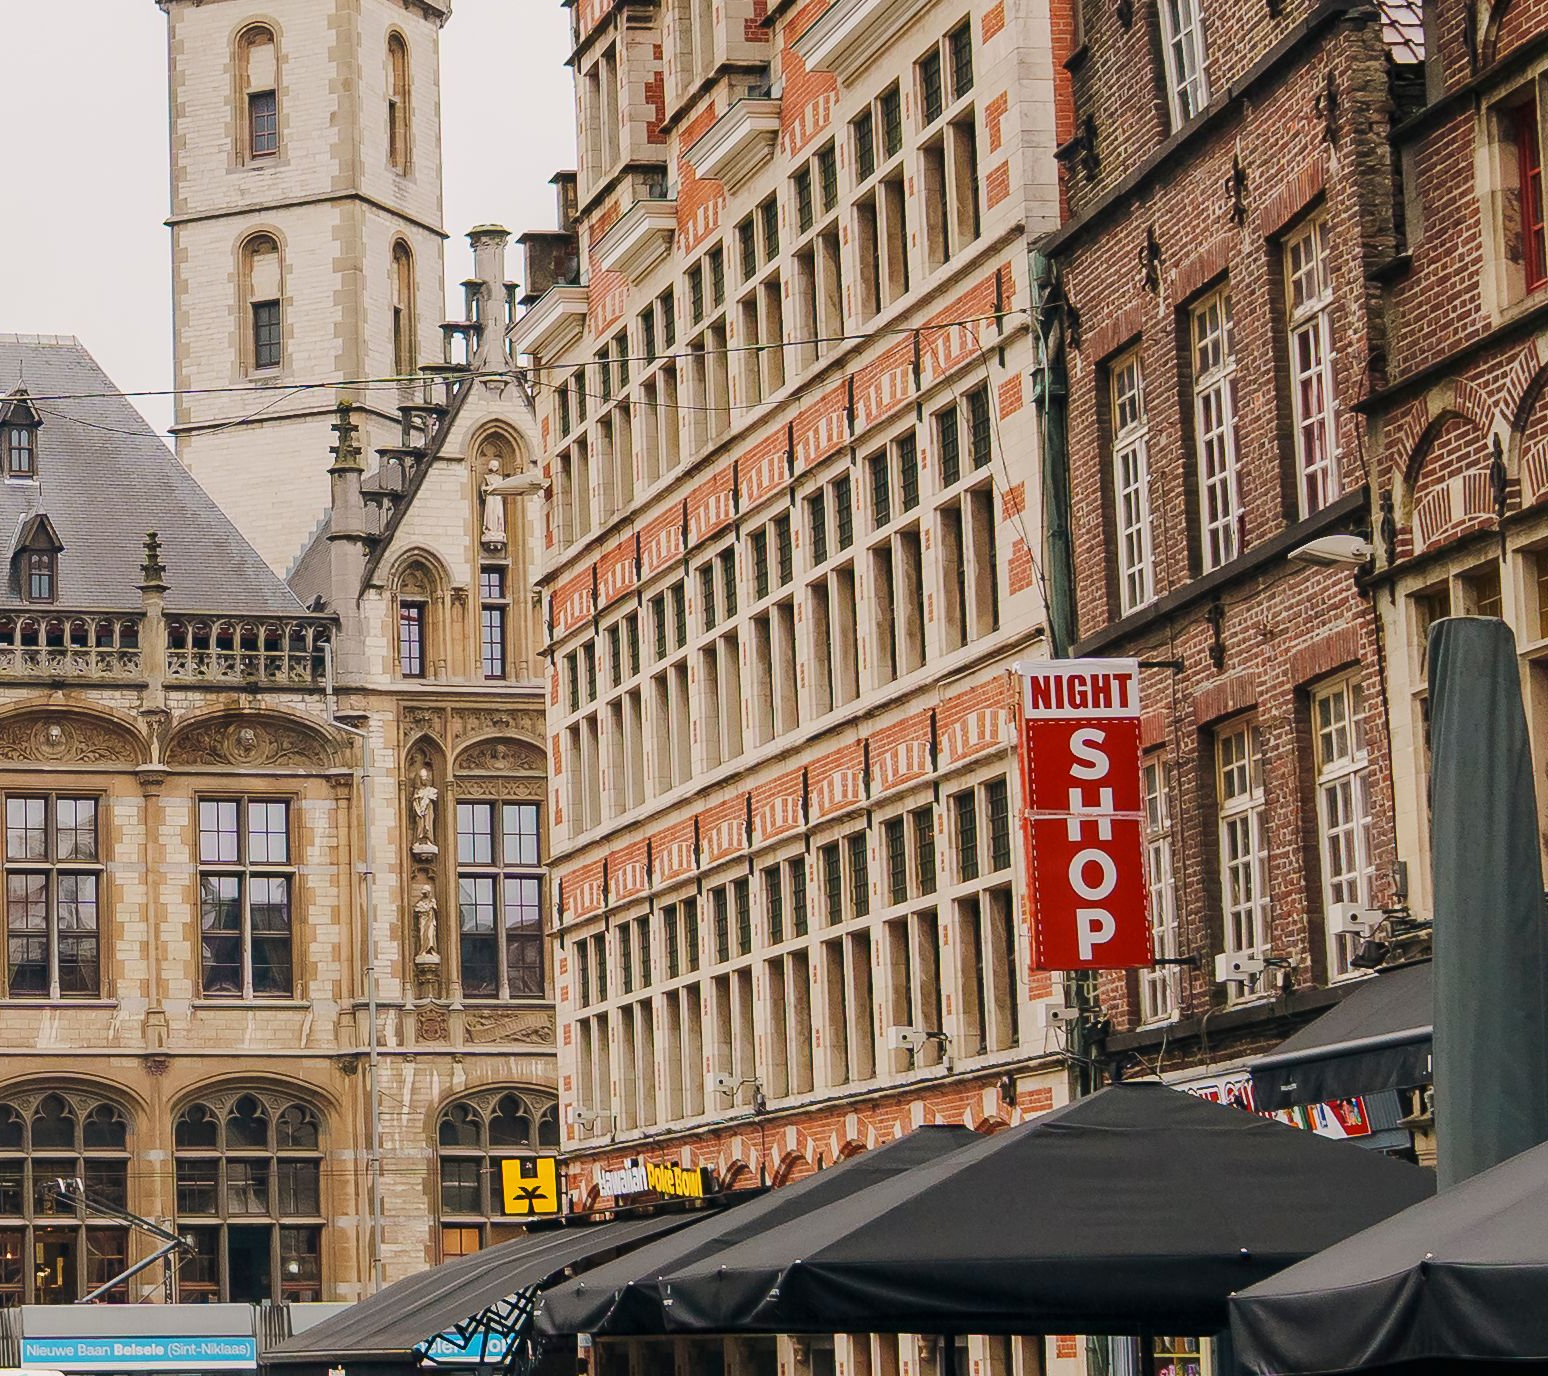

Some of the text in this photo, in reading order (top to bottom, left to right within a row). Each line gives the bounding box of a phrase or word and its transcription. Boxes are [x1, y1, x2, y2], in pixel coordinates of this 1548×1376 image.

[1031, 674, 1132, 710] NIGHT
[1067, 727, 1117, 960] SHOP
[598, 1156, 648, 1197] Hawaiian
[675, 1167, 703, 1197] Bowl
[26, 1342, 251, 1359] Nieuwe Baan Belsele (Sint-Niklaas)
